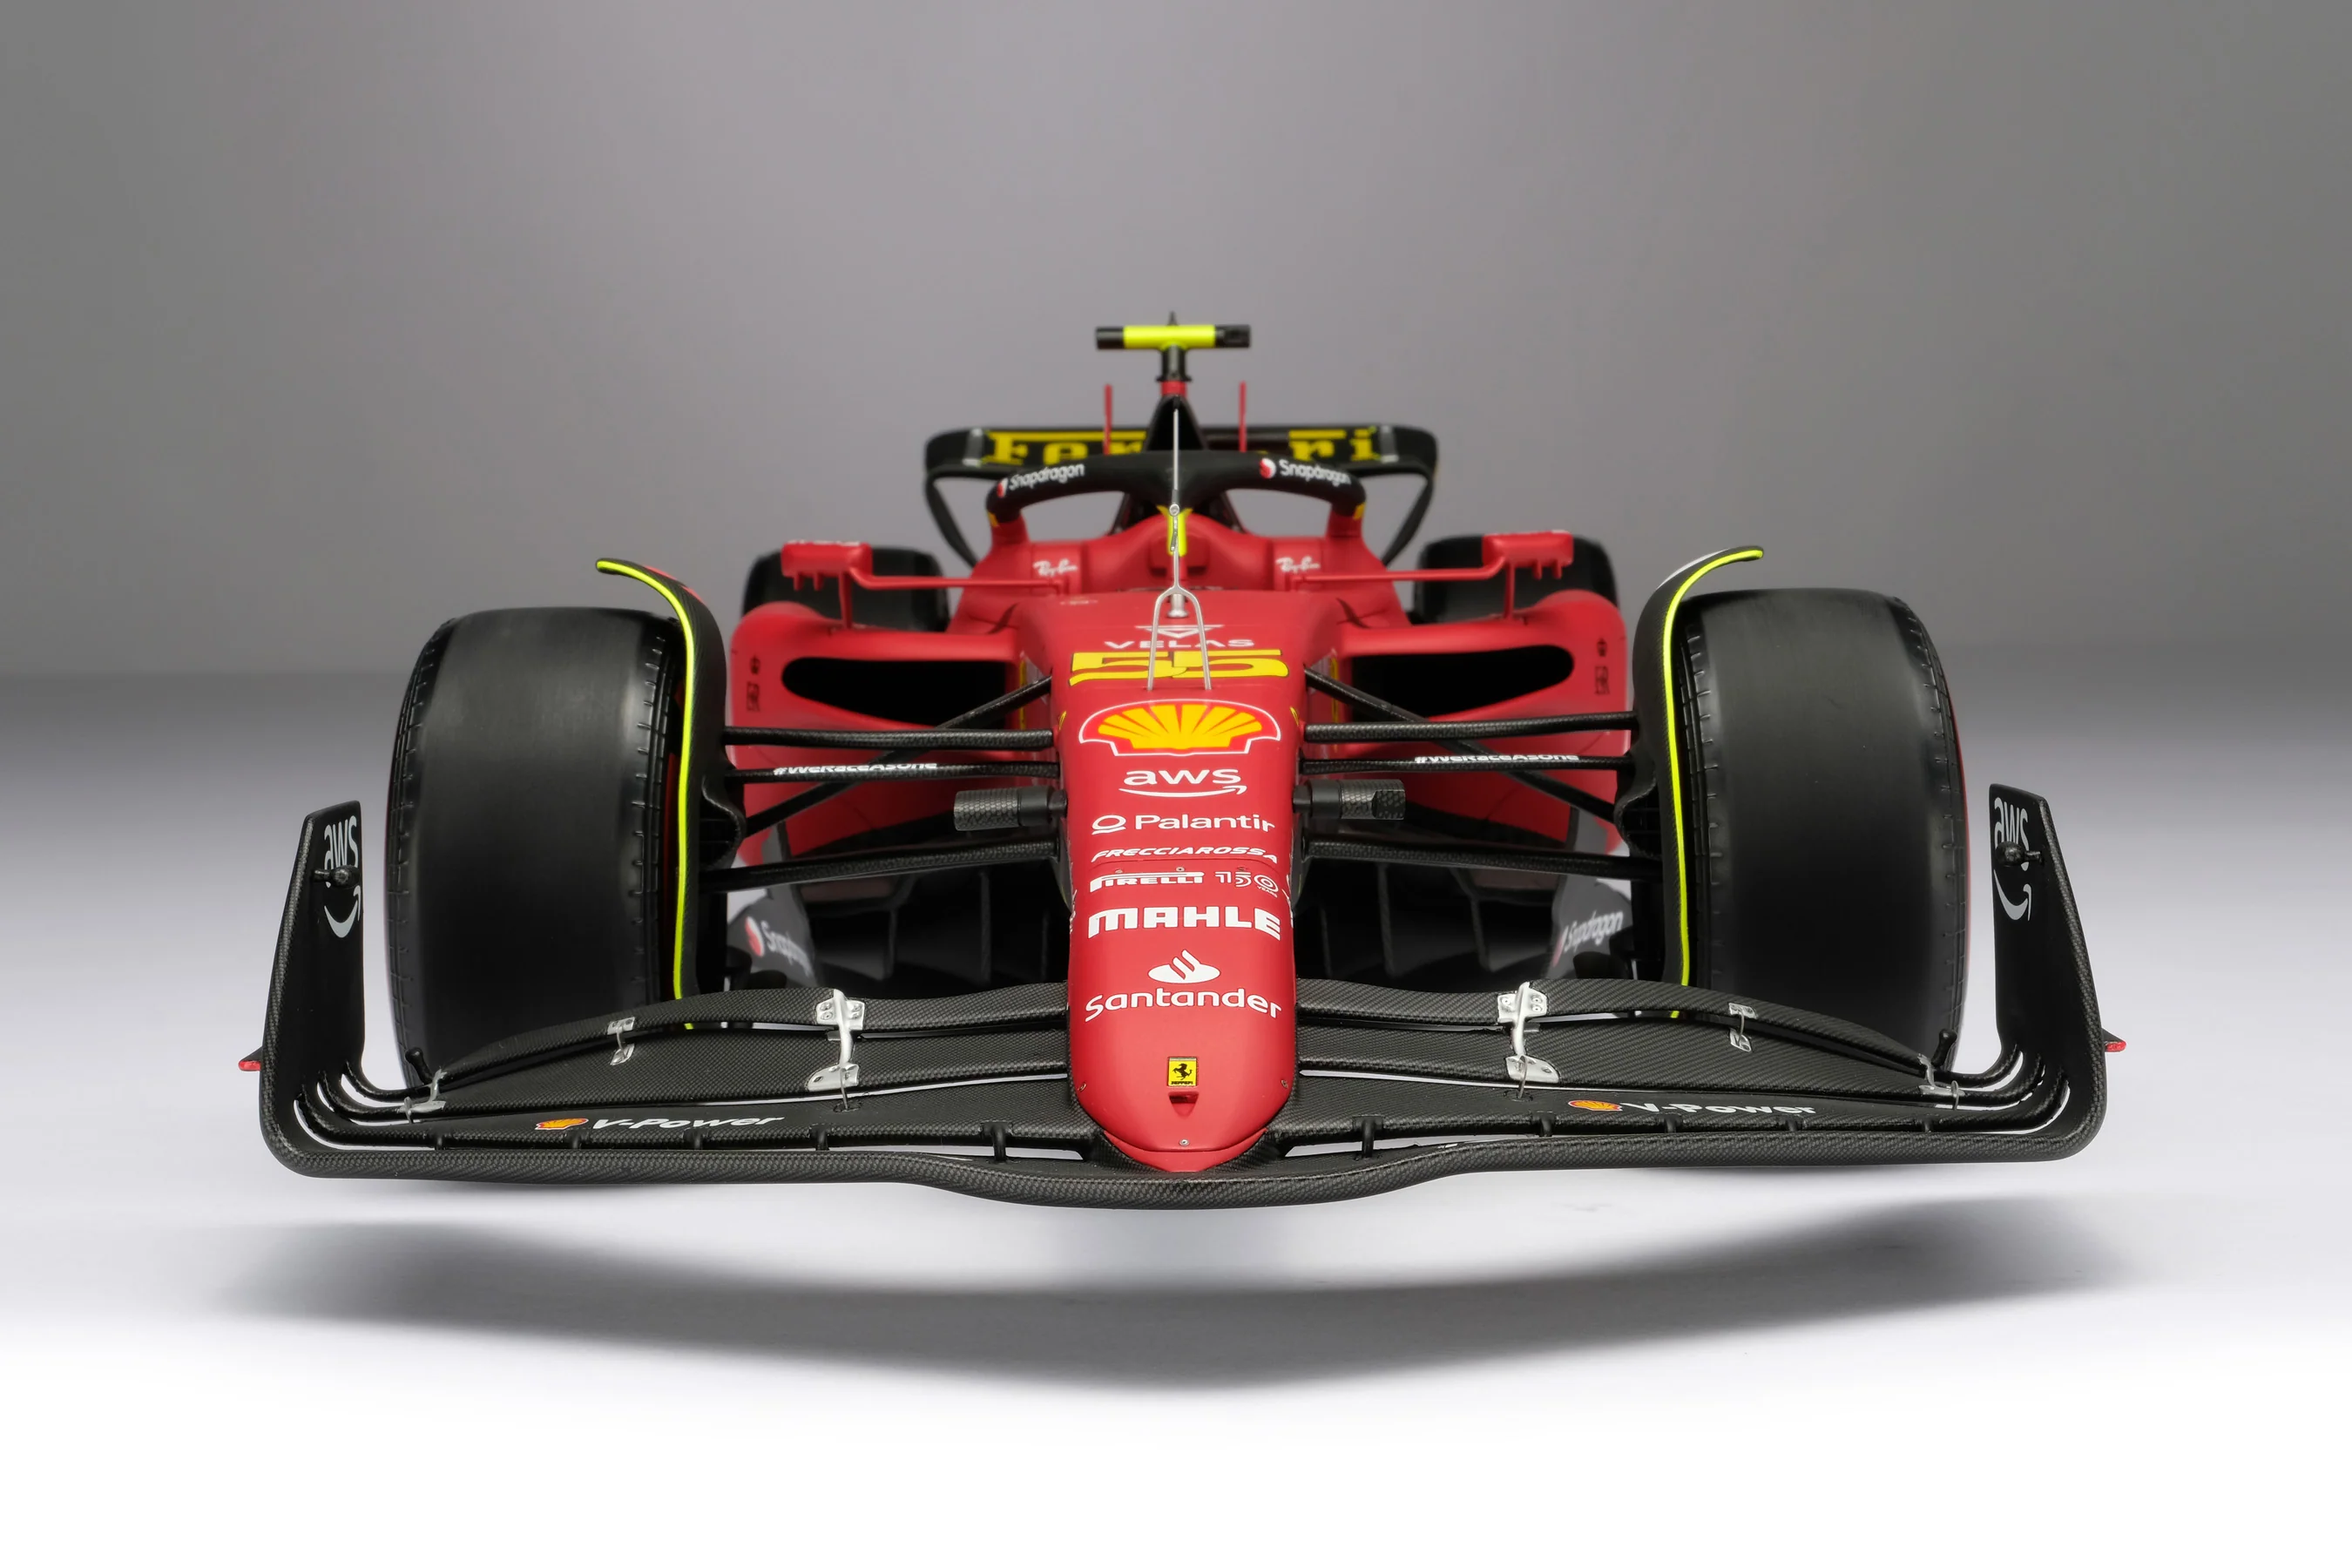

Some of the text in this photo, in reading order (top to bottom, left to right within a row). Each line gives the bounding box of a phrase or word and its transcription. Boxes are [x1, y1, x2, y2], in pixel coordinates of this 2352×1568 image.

[1009, 463, 1085, 490] Snapdragon
[1279, 459, 1351, 487] Snapdragon
[1104, 639, 1254, 649] VELAS
[1069, 649, 1289, 686] 55
[1124, 768, 1241, 785] aws
[1136, 814, 1275, 833] Palantir
[324, 815, 359, 888] aws
[1091, 846, 1278, 864] FRECCIAROSSA
[1090, 871, 1205, 893] PIRELLI
[1087, 906, 1281, 941] MAHLE
[1085, 988, 1281, 1022] Santander
[1620, 1102, 1816, 1114] V-Power
[592, 1117, 785, 1130] V-Power
